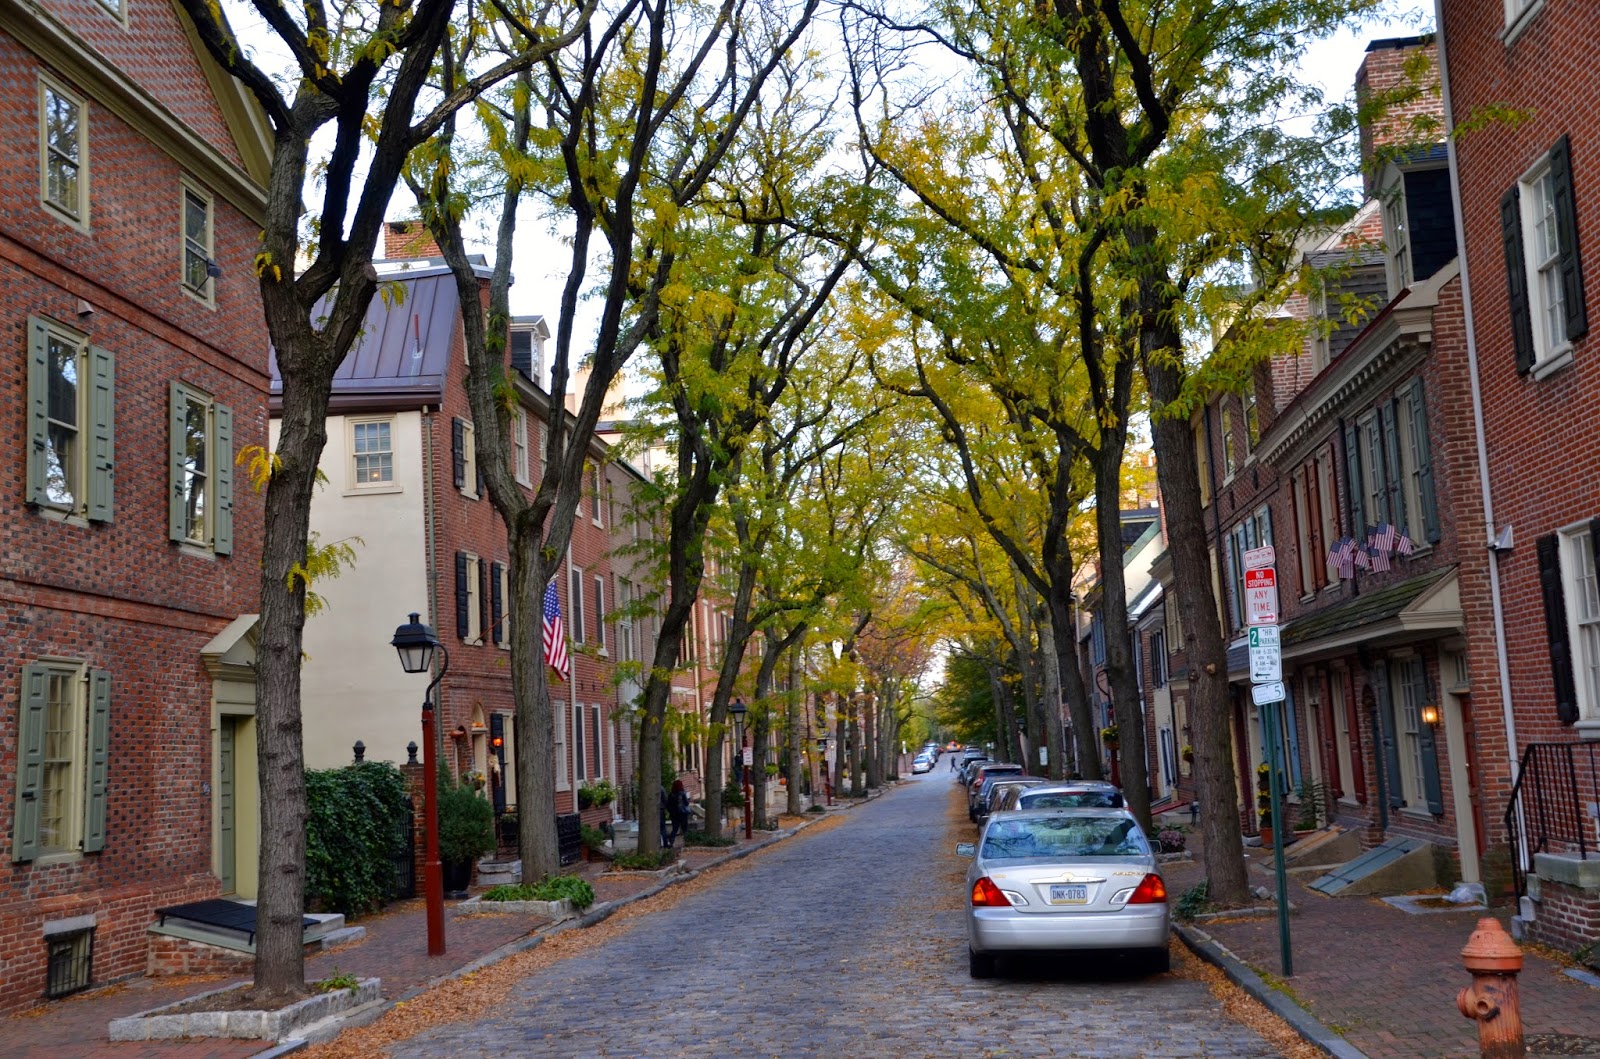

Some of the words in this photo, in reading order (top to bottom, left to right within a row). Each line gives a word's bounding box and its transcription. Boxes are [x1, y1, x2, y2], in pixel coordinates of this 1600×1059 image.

[1256, 570, 1264, 578] NO
[1248, 578, 1272, 588] STOPPING
[1254, 590, 1268, 599] ANY
[1253, 602, 1270, 612] TIME
[1251, 630, 1257, 644] 2
[1259, 636, 1278, 644] PARKING
[1274, 685, 1280, 697] 5
